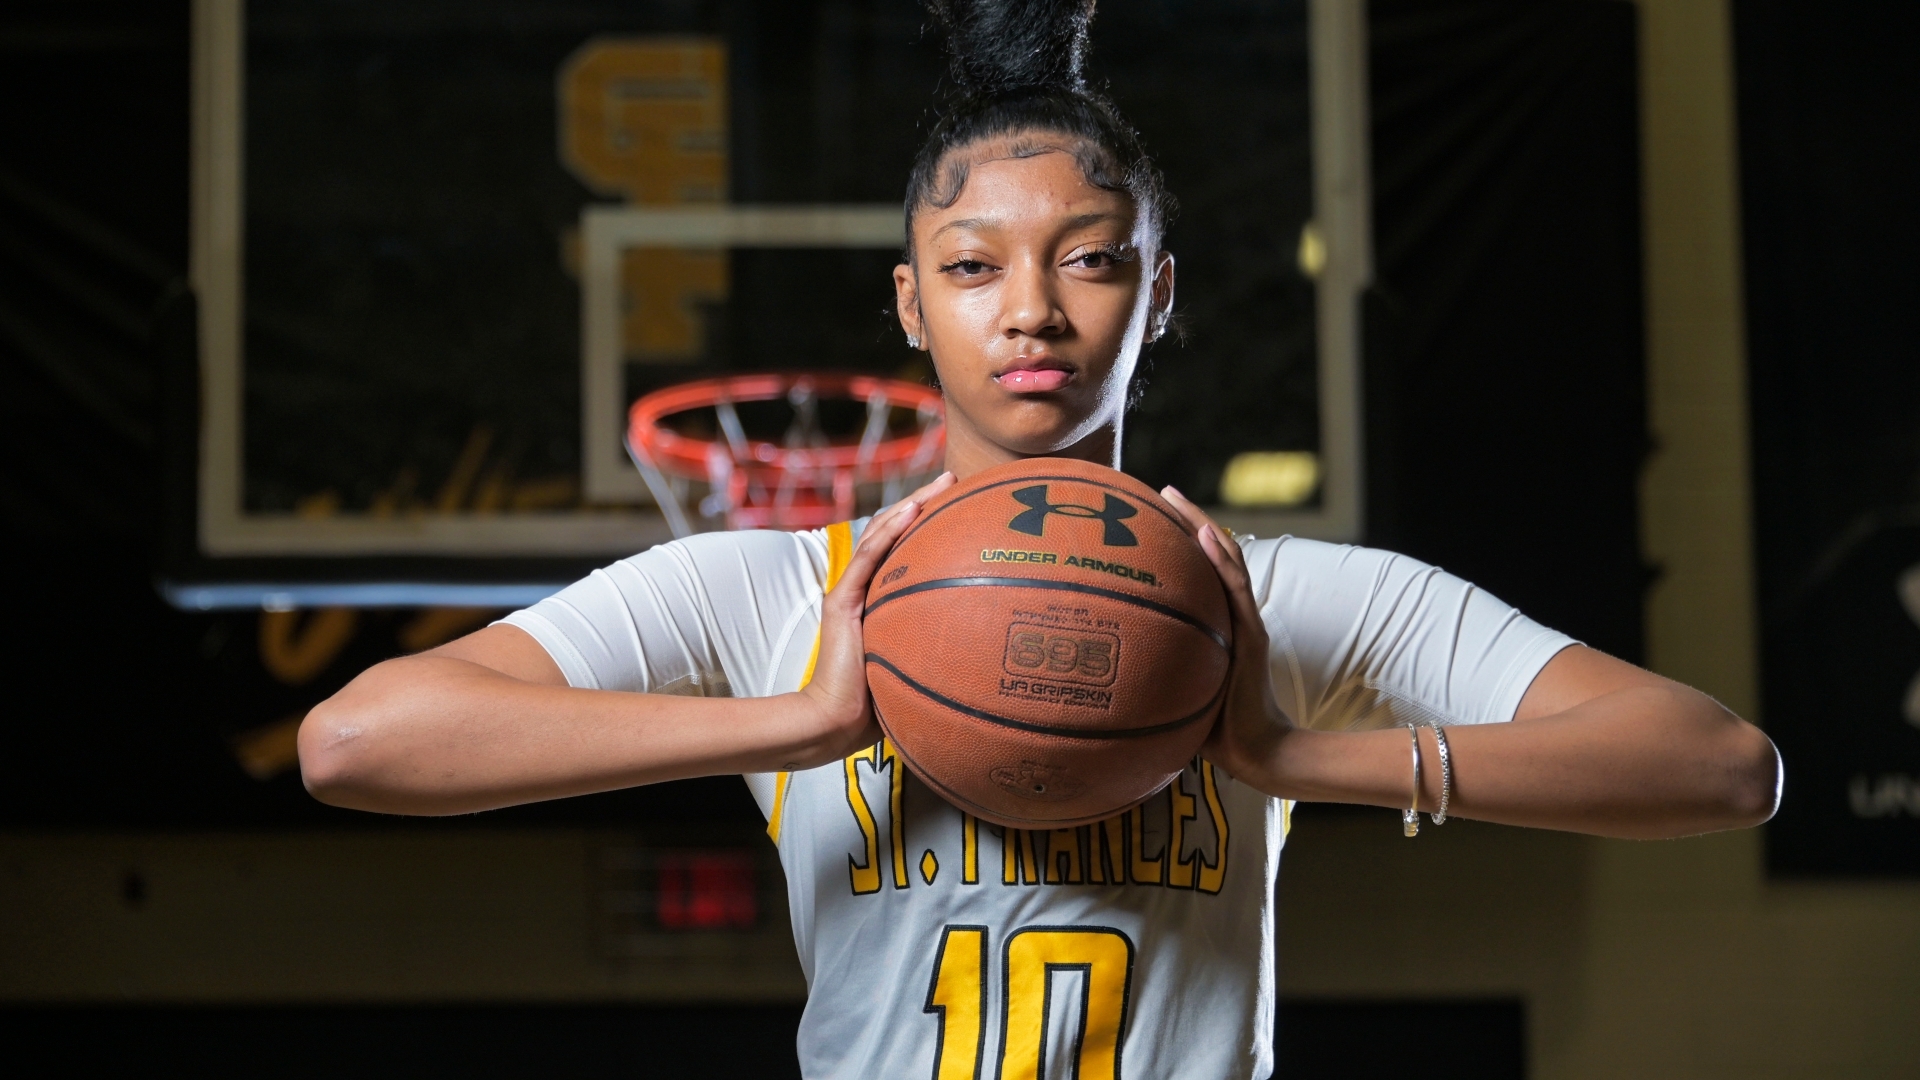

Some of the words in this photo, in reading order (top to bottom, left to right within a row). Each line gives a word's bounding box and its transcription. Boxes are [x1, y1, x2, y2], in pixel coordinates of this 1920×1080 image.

[981, 549, 1058, 565] UNDER
[1063, 554, 1158, 588] ARMOUR
[1010, 632, 1112, 677] 695
[1000, 679, 1028, 692] UA
[1031, 683, 1112, 703] GRIPSKIN
[843, 738, 940, 896] ST.
[923, 924, 1134, 1080] 10
